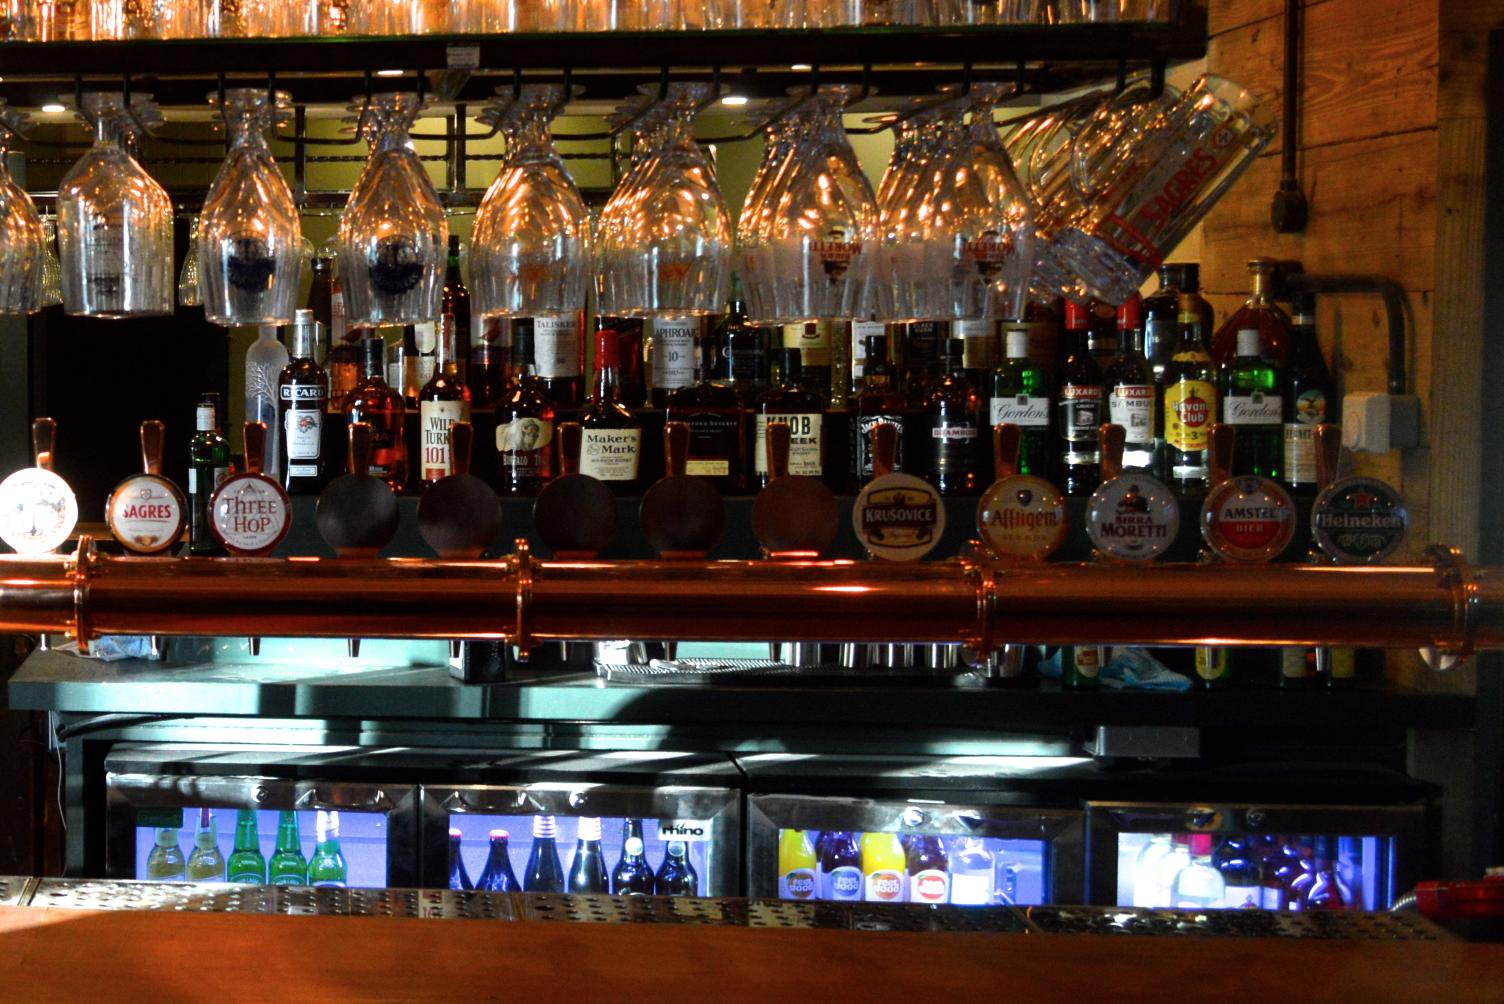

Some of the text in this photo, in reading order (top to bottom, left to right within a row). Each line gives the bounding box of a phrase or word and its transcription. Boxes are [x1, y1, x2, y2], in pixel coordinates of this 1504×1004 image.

[1138, 147, 1217, 232] SAGRES
[668, 352, 678, 361] 10
[1179, 412, 1205, 422] Club
[425, 430, 449, 445] TURK
[426, 447, 446, 463] 101
[601, 444, 636, 453] Mark
[123, 504, 171, 519] SAGRES
[1225, 507, 1278, 519] AMSTEL
[1115, 516, 1153, 524] BIRRA
[1321, 511, 1403, 527] Heineken
[1100, 523, 1168, 538] MORETTI
[662, 822, 704, 835] rhino
